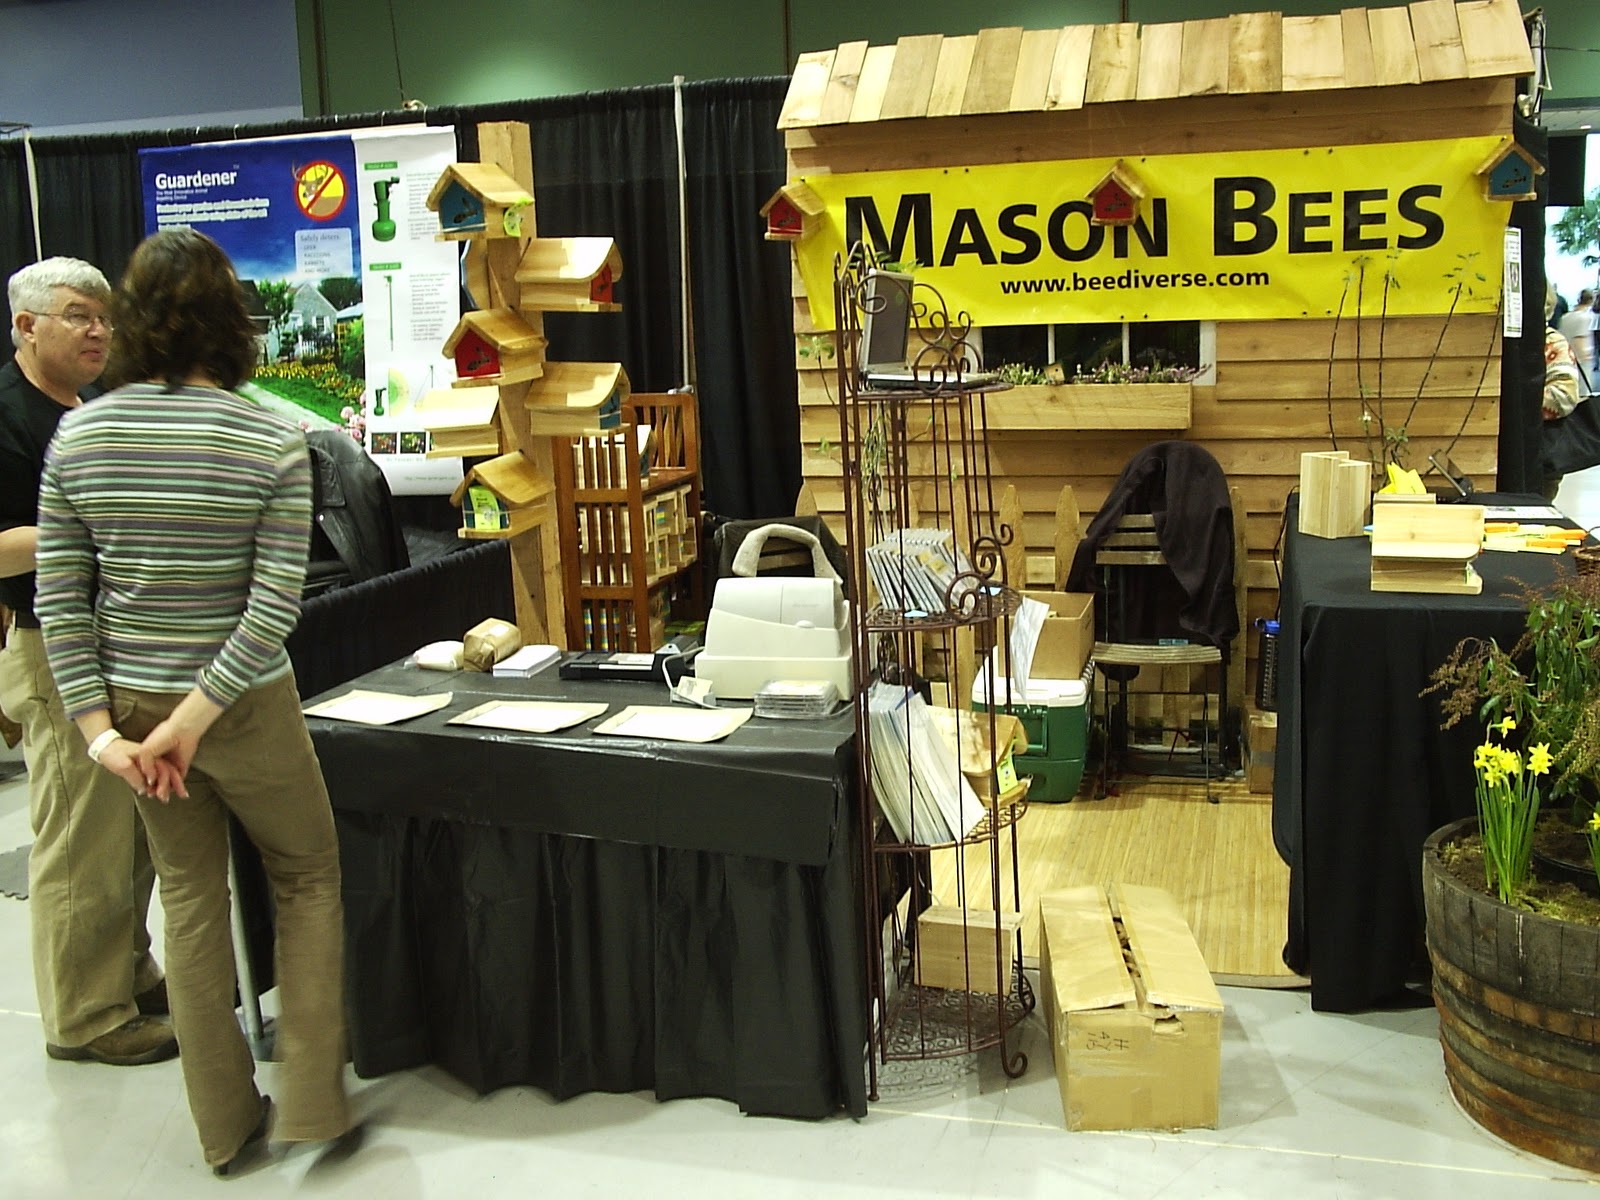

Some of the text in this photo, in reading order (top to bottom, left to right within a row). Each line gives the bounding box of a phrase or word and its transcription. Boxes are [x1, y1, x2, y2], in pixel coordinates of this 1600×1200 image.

[155, 170, 237, 189] Guardener
[845, 176, 1445, 268] MASON BEES
[1001, 270, 1270, 294] www.beediverse.com
